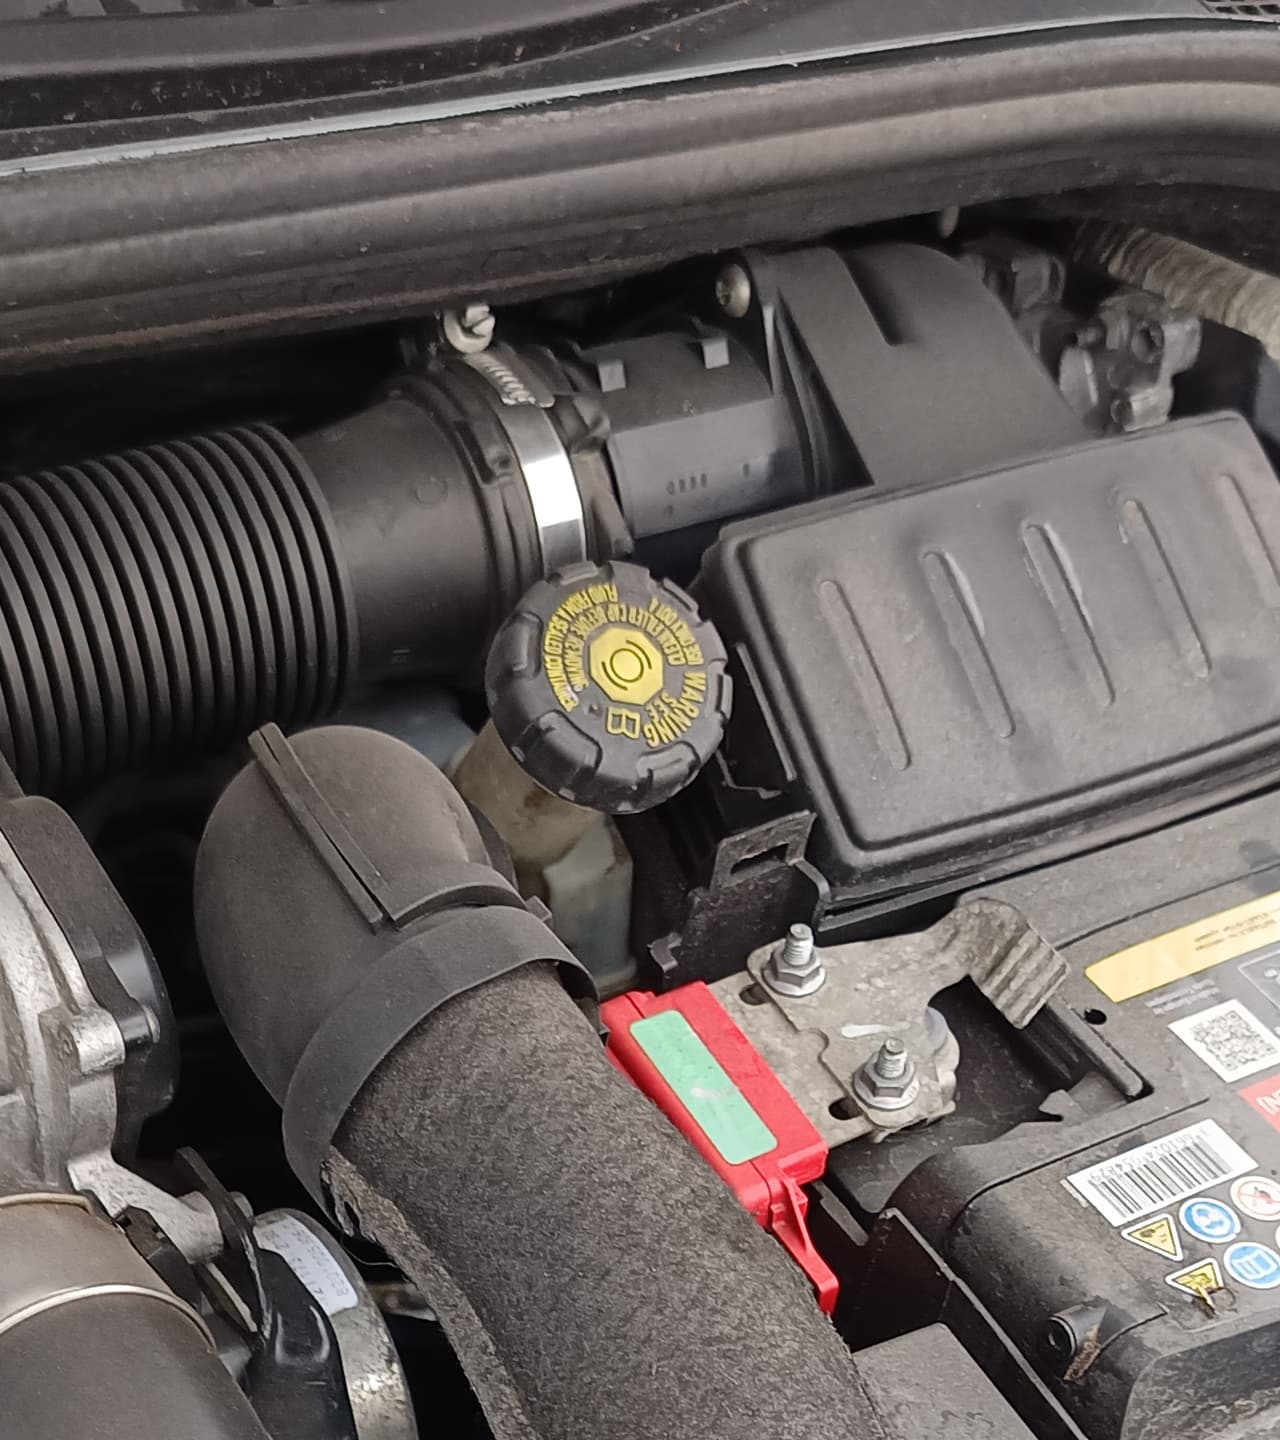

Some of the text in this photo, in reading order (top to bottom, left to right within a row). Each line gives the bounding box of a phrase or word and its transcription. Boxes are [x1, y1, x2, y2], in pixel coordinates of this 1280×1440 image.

[565, 590, 591, 616] FROM
[587, 583, 619, 606] FLUID
[573, 606, 608, 640] BEFORE
[607, 603, 628, 623] CAP
[545, 614, 568, 655] SEALED
[683, 644, 704, 665] USE
[643, 671, 707, 748] WARNING
[645, 692, 674, 723] SEE
